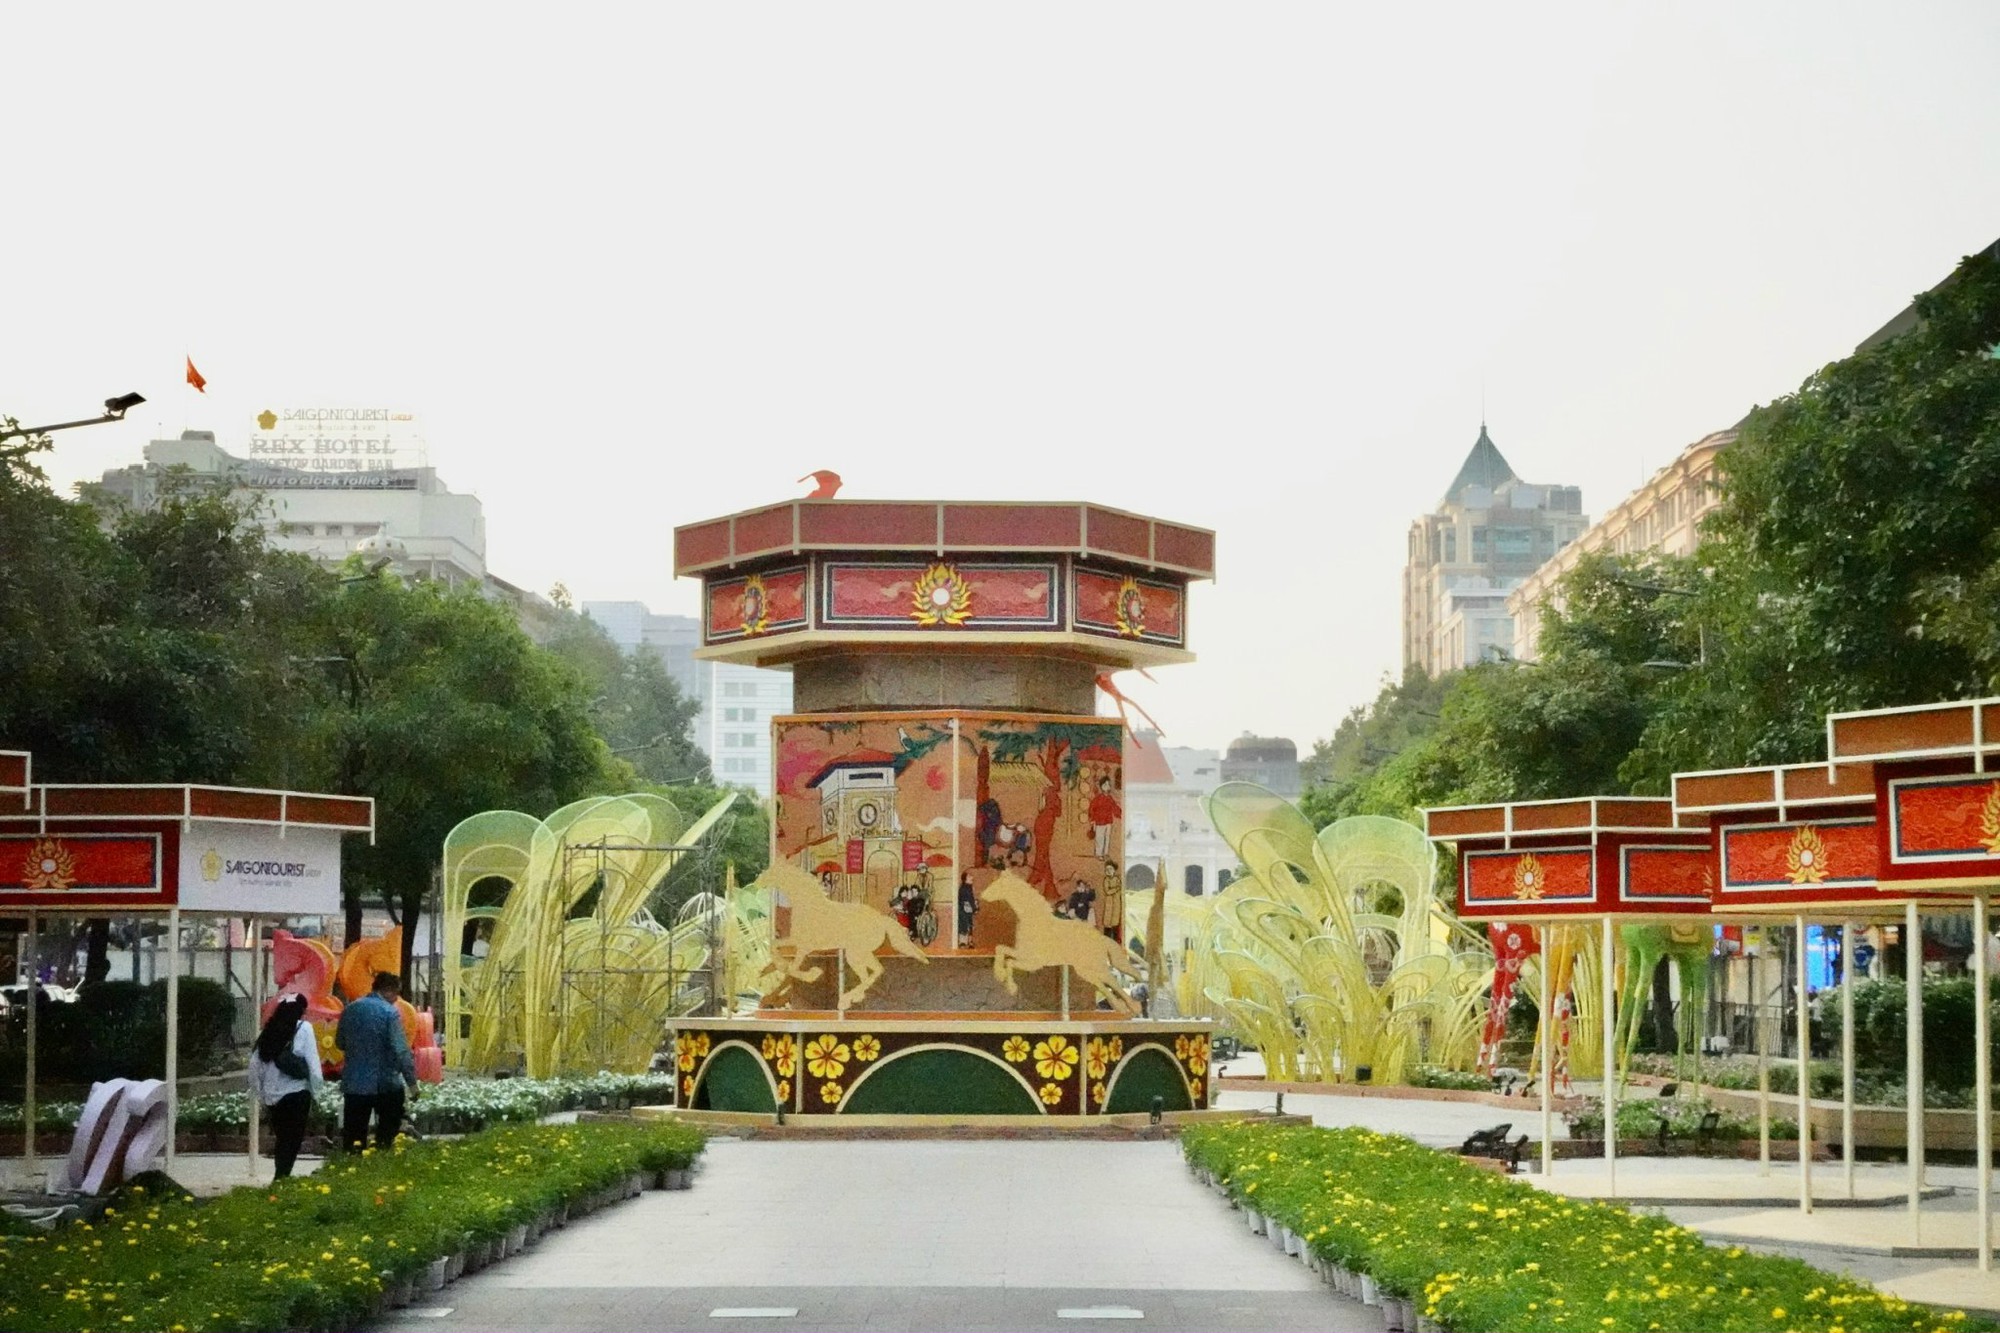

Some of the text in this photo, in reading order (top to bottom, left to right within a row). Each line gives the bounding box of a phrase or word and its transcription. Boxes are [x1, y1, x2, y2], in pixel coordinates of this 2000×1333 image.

[283, 409, 389, 421] SAIGONTOURIST
[251, 438, 398, 454] REX HOTEL
[225, 860, 306, 878] SAIGONTOURIST
